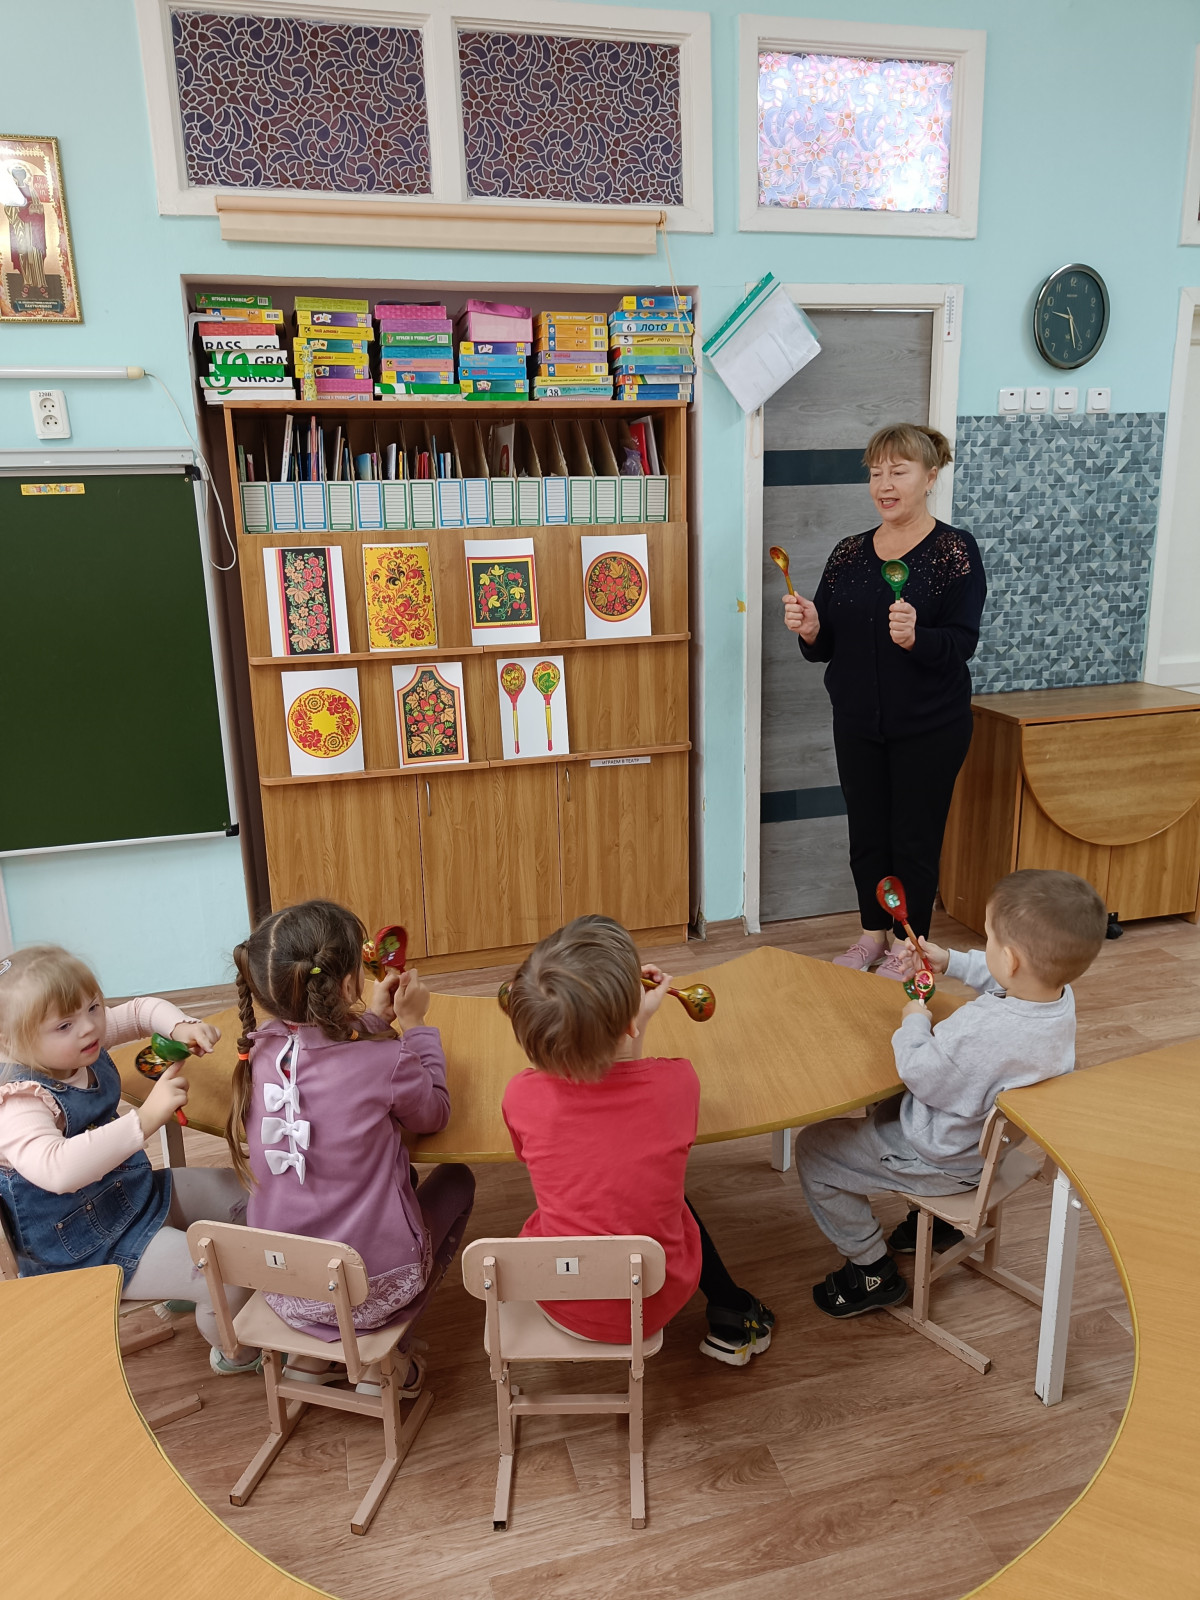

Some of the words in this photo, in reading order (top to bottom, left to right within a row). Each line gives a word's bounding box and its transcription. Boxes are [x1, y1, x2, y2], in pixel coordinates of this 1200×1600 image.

[1070, 277, 1077, 287] 12
[1047, 296, 1054, 307] 10
[1090, 297, 1096, 307] 2
[1044, 313, 1049, 321] 9
[626, 324, 632, 332] 6
[640, 323, 668, 331] ЛОТО
[1044, 328, 1050, 338] 8
[623, 335, 629, 344] 5
[1051, 343, 1056, 352] 7
[1077, 342, 1083, 351] 5
[1063, 350, 1069, 359] 6
[254, 356, 288, 364] GRA
[548, 389, 559, 397] 38
[272, 1255, 278, 1265] 1
[564, 1261, 570, 1271] 1
